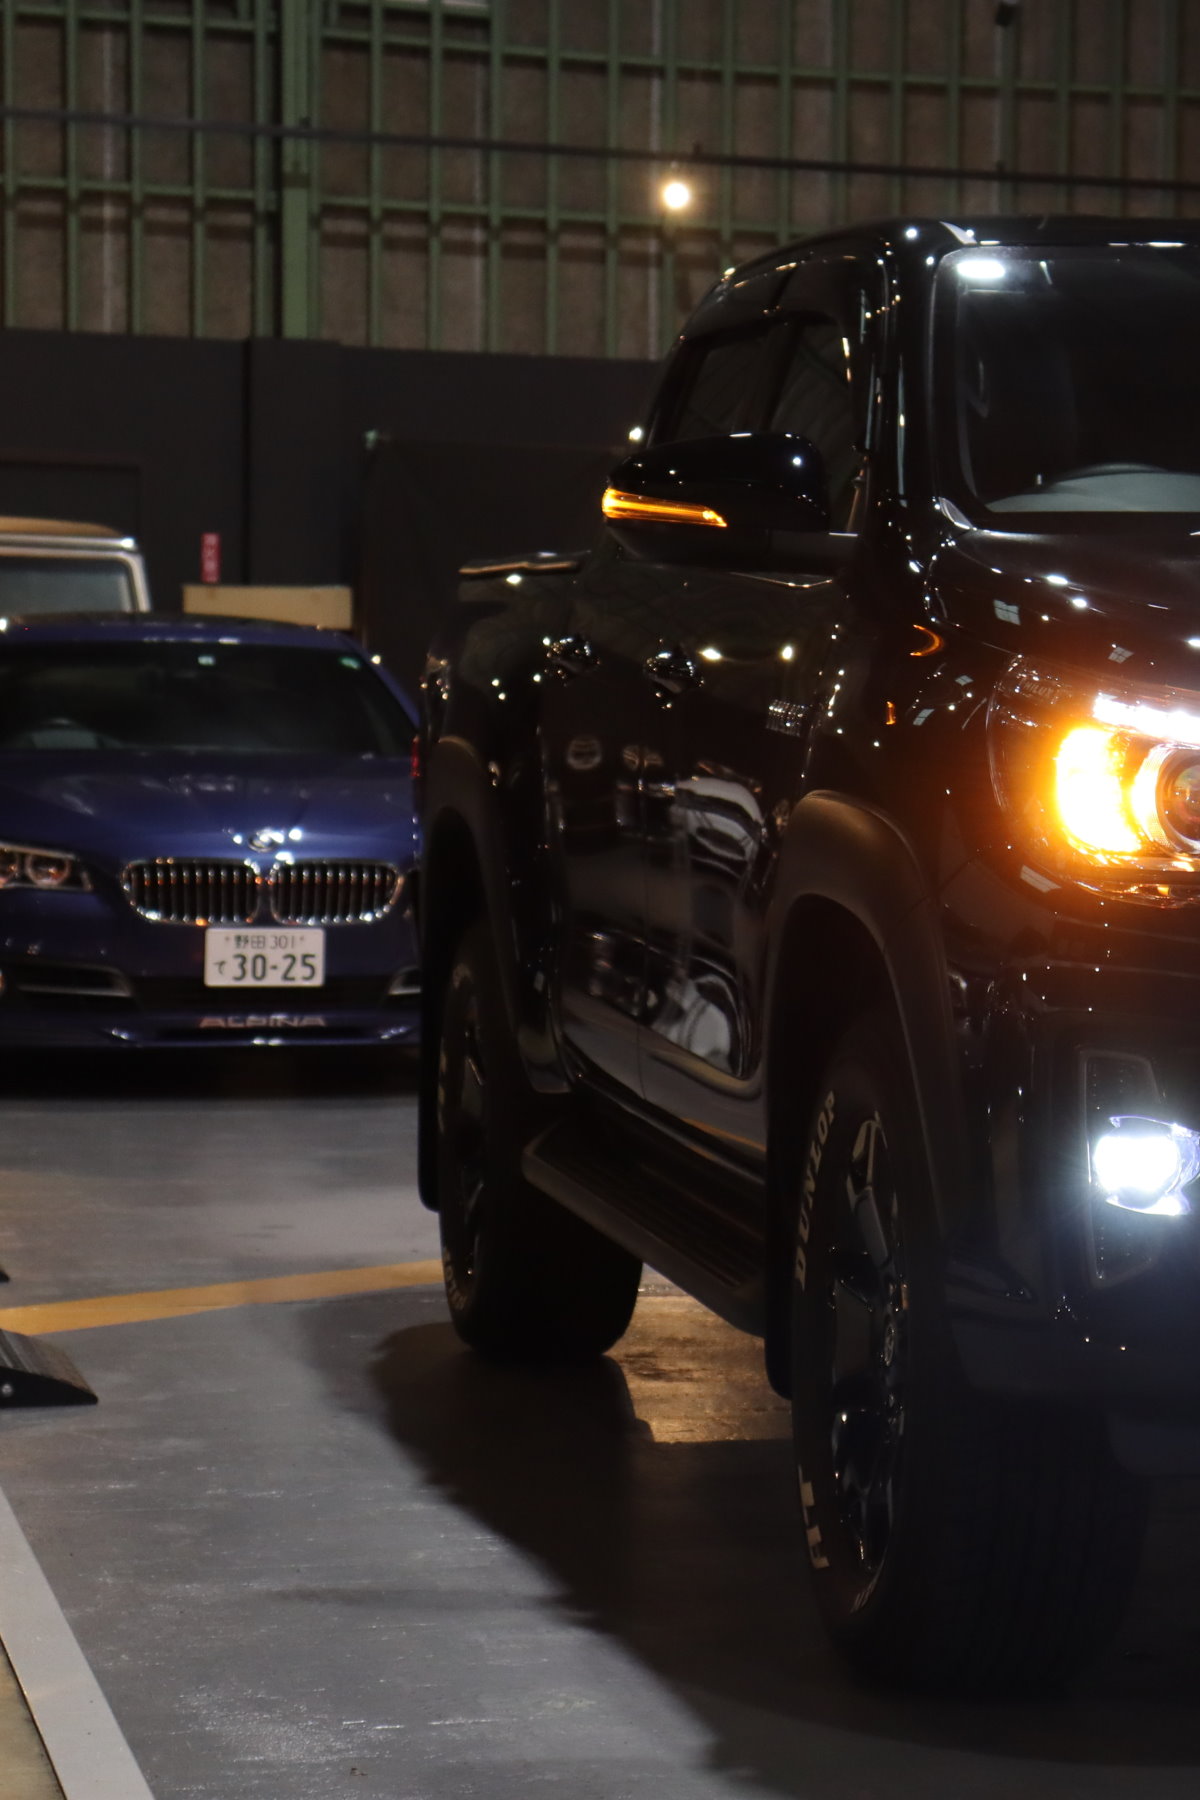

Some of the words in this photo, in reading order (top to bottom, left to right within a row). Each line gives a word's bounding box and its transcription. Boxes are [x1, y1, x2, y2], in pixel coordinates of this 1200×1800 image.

[269, 934, 296, 949] 301
[232, 953, 317, 982] 30-25
[200, 1016, 326, 1028] ALPINA
[794, 1090, 835, 1291] DUNLOP
